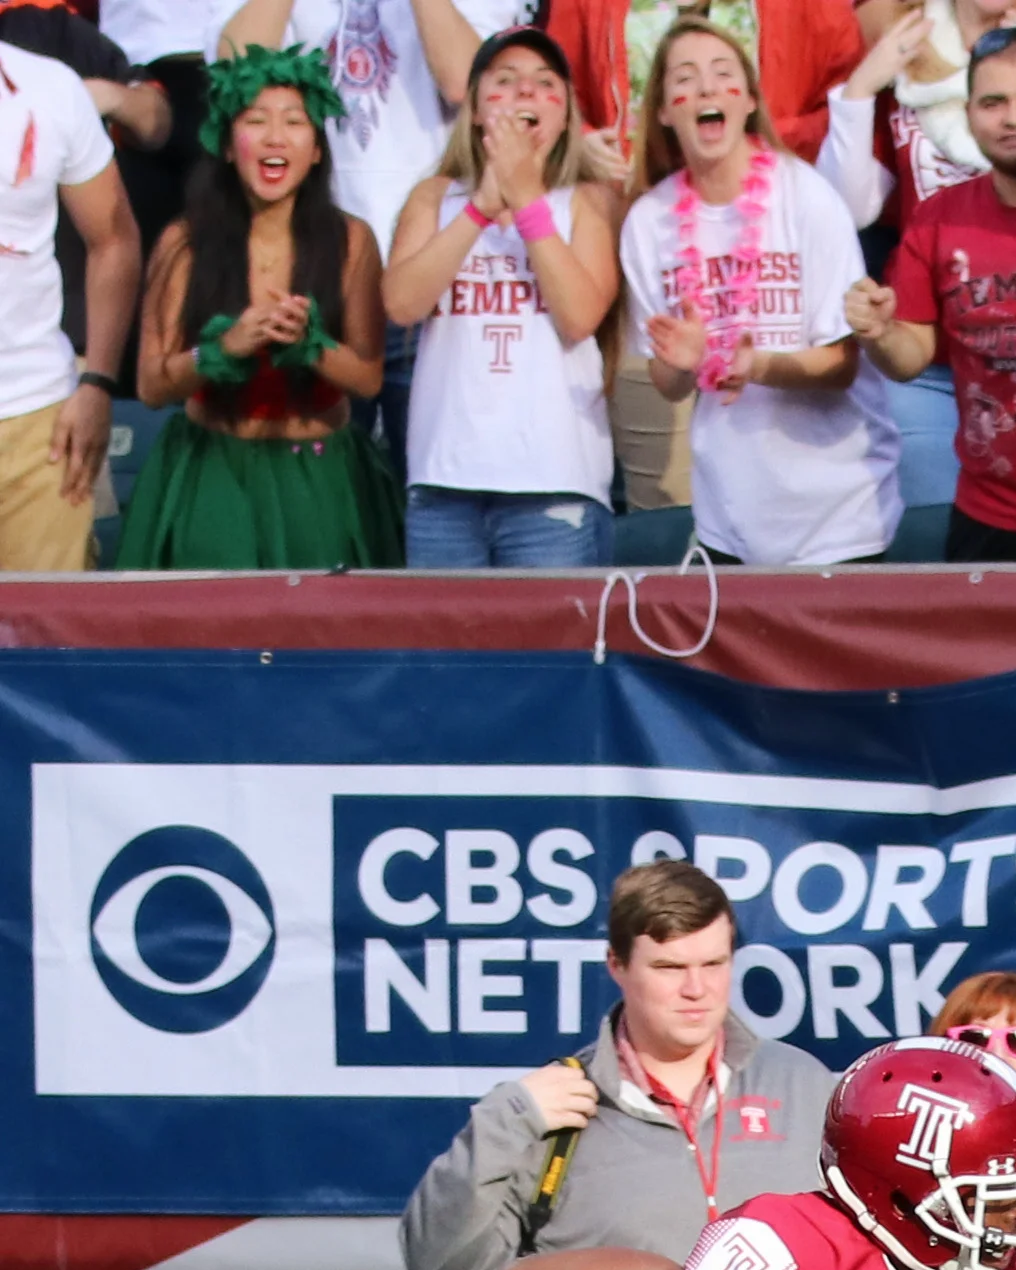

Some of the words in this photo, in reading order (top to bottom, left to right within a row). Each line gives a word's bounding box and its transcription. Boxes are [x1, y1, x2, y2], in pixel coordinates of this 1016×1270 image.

[432, 280, 549, 318] EMPL
[482, 324, 522, 373] T
[358, 827, 598, 927] CBS
[364, 938, 970, 1039] NETORK
[740, 1106, 766, 1133] T
[897, 1083, 968, 1170] T
